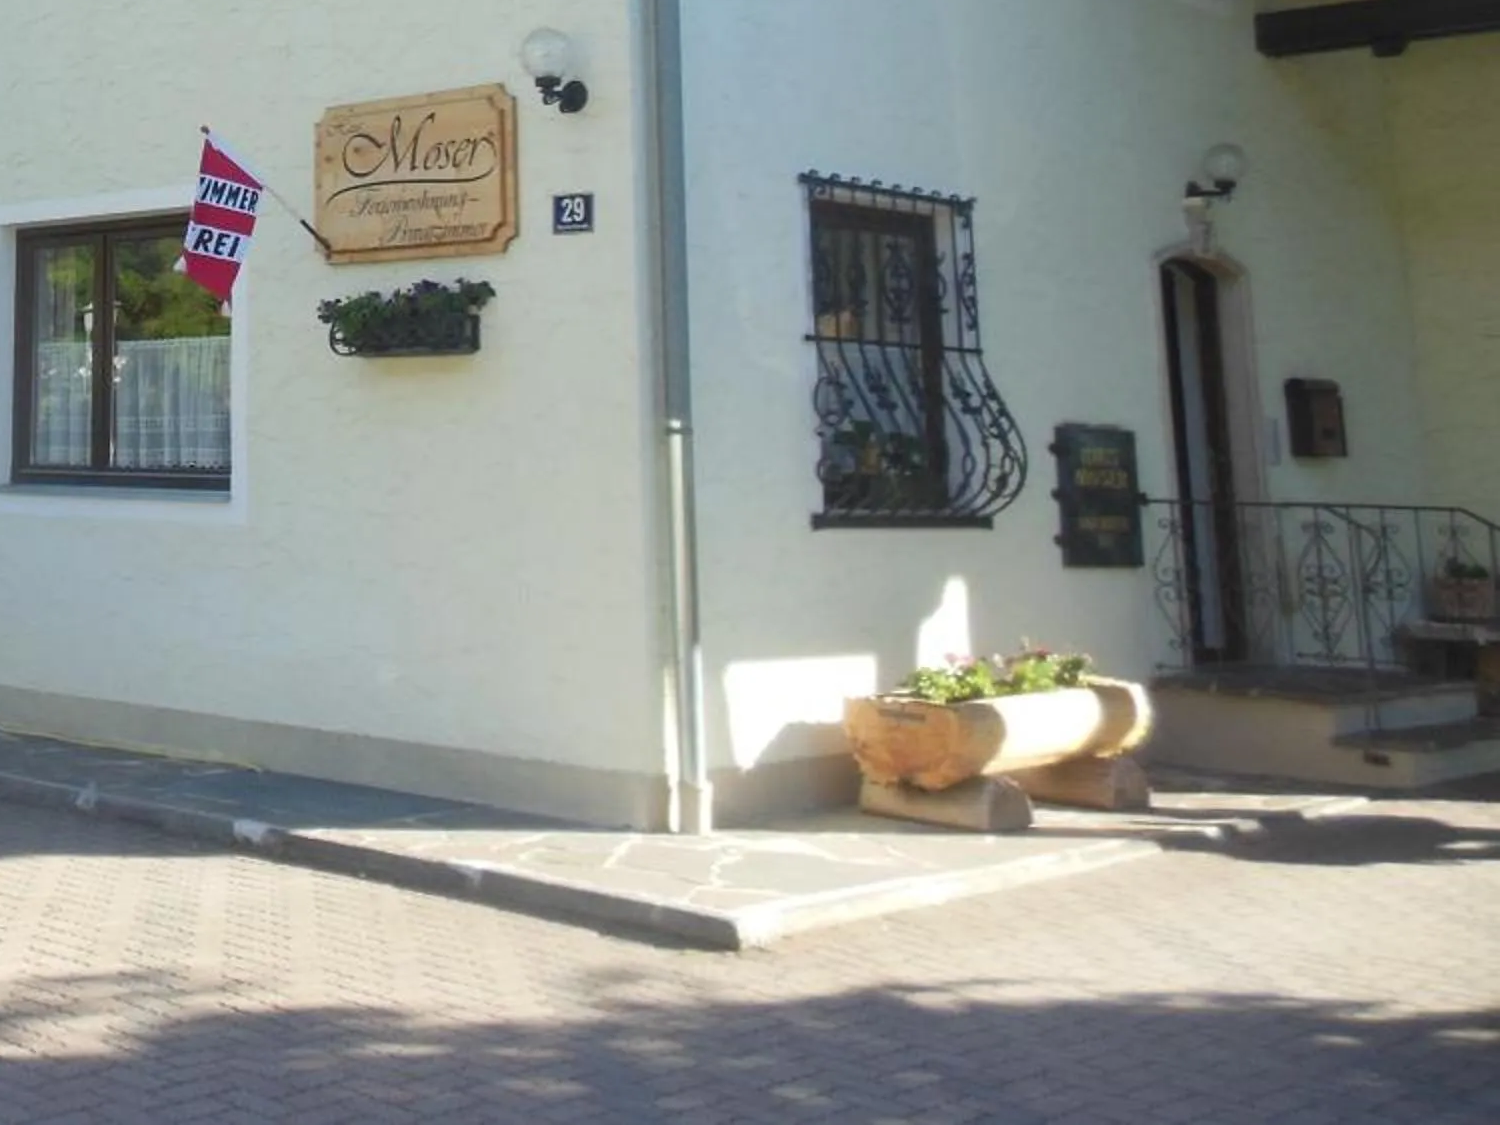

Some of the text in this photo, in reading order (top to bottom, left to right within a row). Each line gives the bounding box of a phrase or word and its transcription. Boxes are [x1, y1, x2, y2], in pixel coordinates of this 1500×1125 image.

[342, 111, 498, 178] Moser
[560, 196, 586, 223] 29
[192, 226, 241, 258] REI
